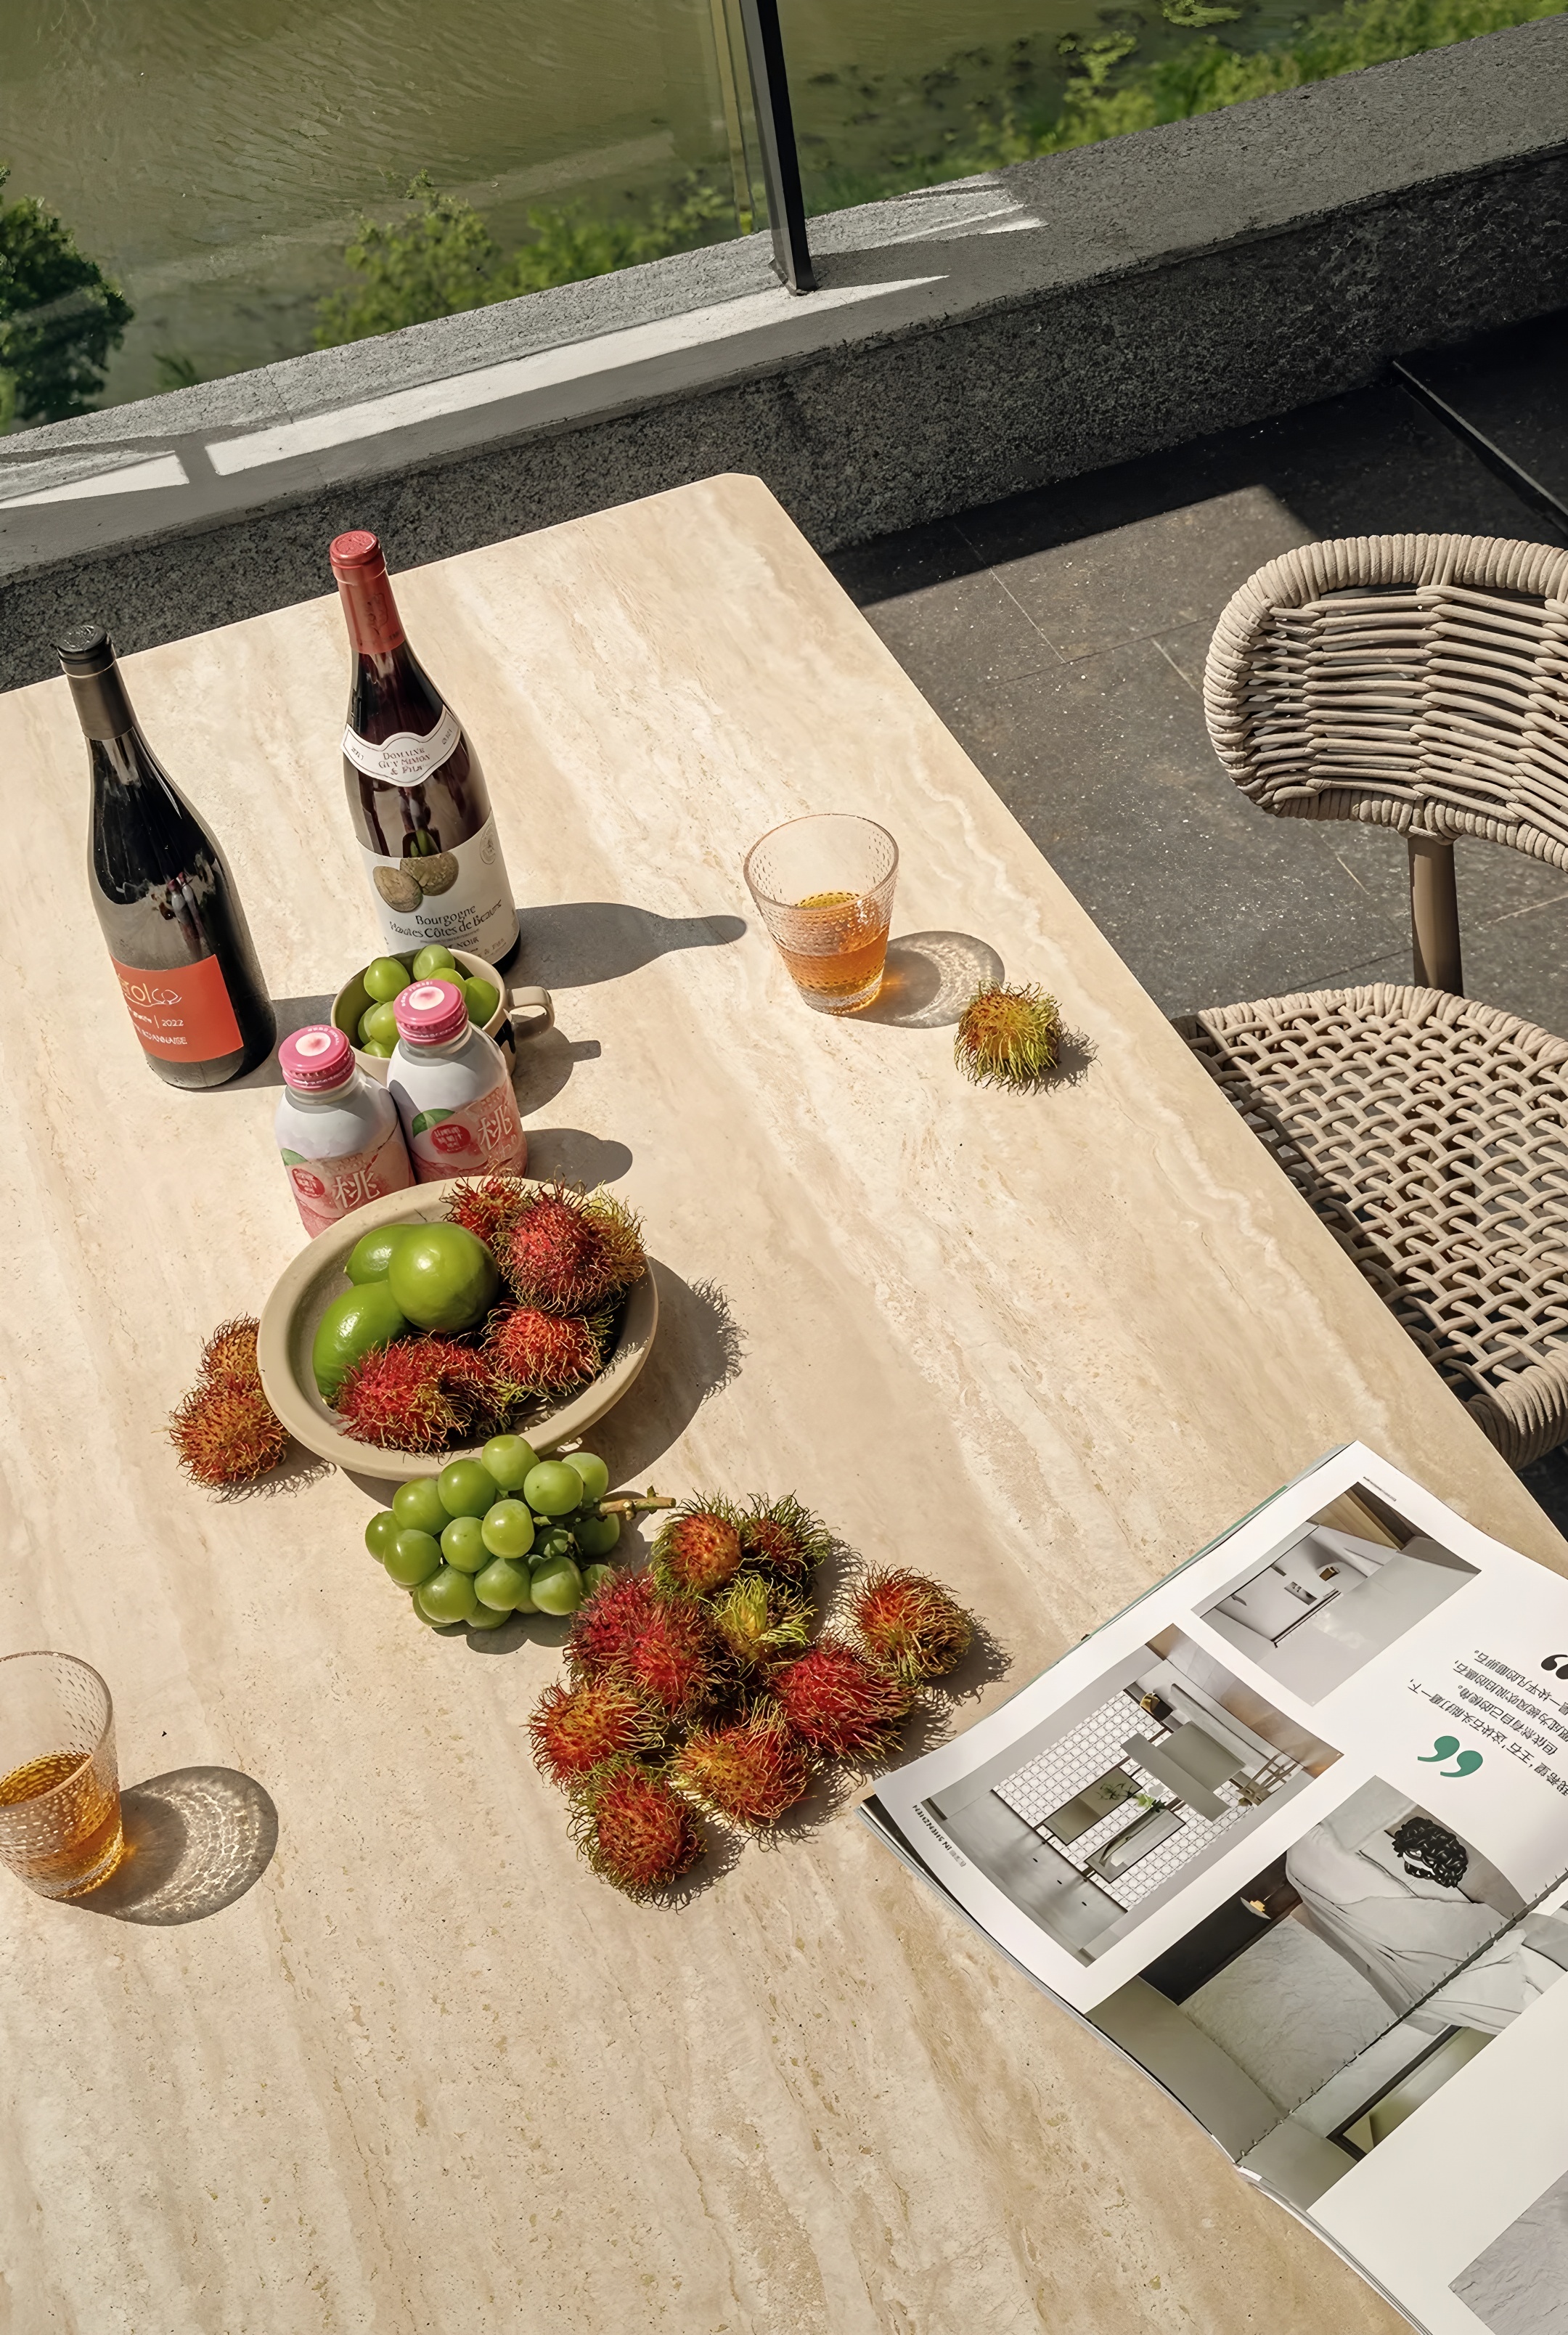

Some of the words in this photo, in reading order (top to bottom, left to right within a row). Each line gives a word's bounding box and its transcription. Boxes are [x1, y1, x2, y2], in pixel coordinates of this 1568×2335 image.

[383, 748, 425, 760] DOMAINE
[415, 905, 476, 926] Bourgogne
[425, 926, 457, 938] Côtes
[459, 918, 472, 932] de
[478, 1105, 513, 1150] 桃
[333, 1168, 380, 1208] 桃
